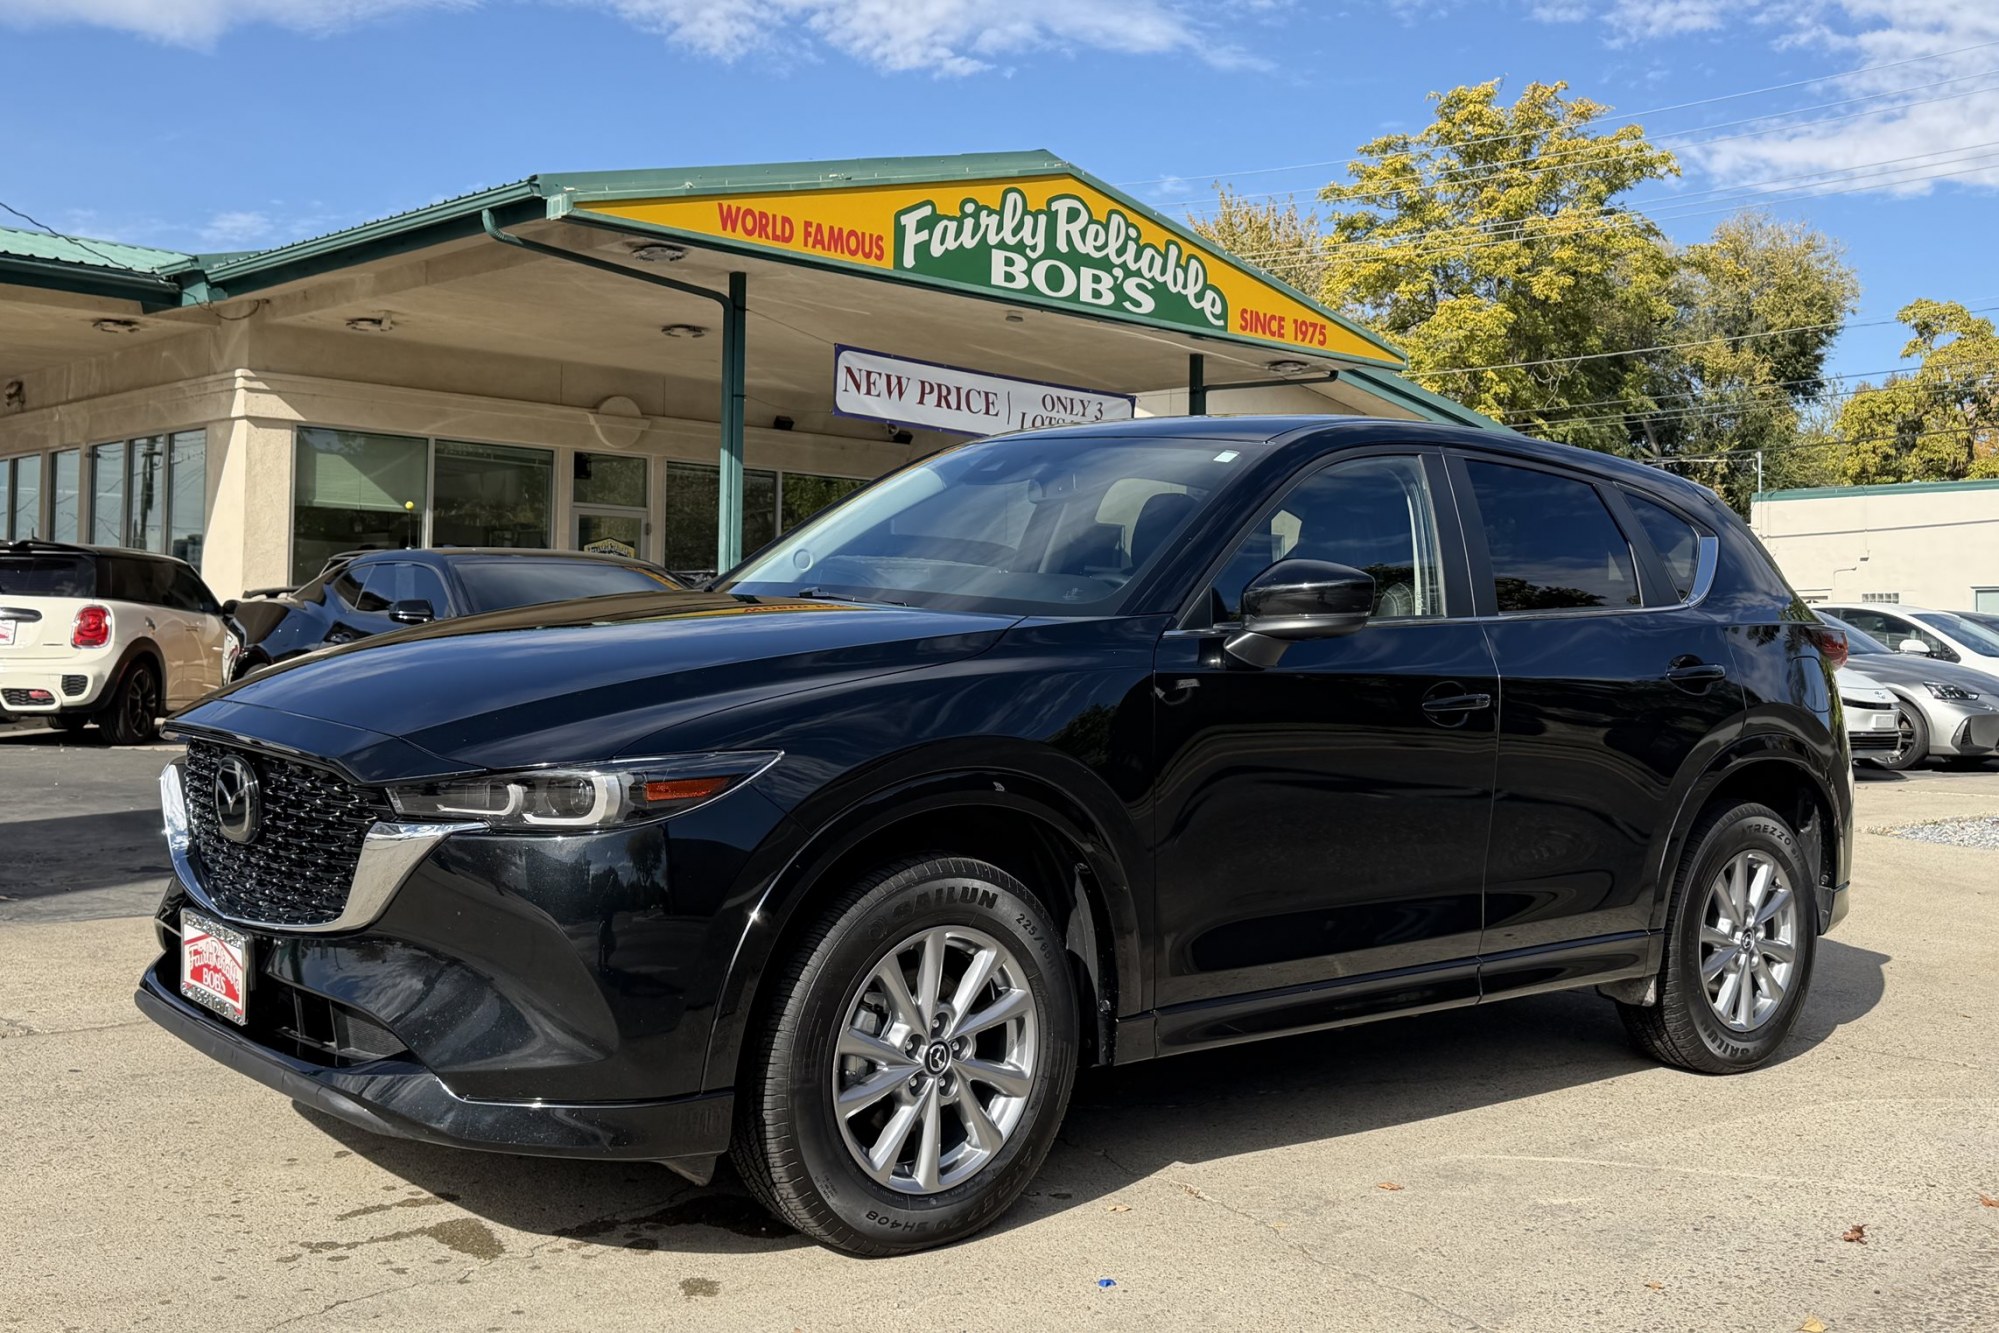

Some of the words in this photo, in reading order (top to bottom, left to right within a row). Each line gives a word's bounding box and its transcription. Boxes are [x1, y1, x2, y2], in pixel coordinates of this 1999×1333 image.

[717, 202, 795, 244] WORLD
[803, 220, 885, 262] FAMOUS
[900, 192, 1047, 269] Fairly
[1051, 198, 1225, 326] Reliable
[991, 248, 1156, 314] BOB'S
[1240, 307, 1285, 339] SINCE
[1293, 318, 1327, 347] 1975
[842, 365, 911, 402] NEW
[916, 379, 1000, 417] PRICE
[1042, 394, 1091, 418] ONLY
[1094, 401, 1104, 421] 3
